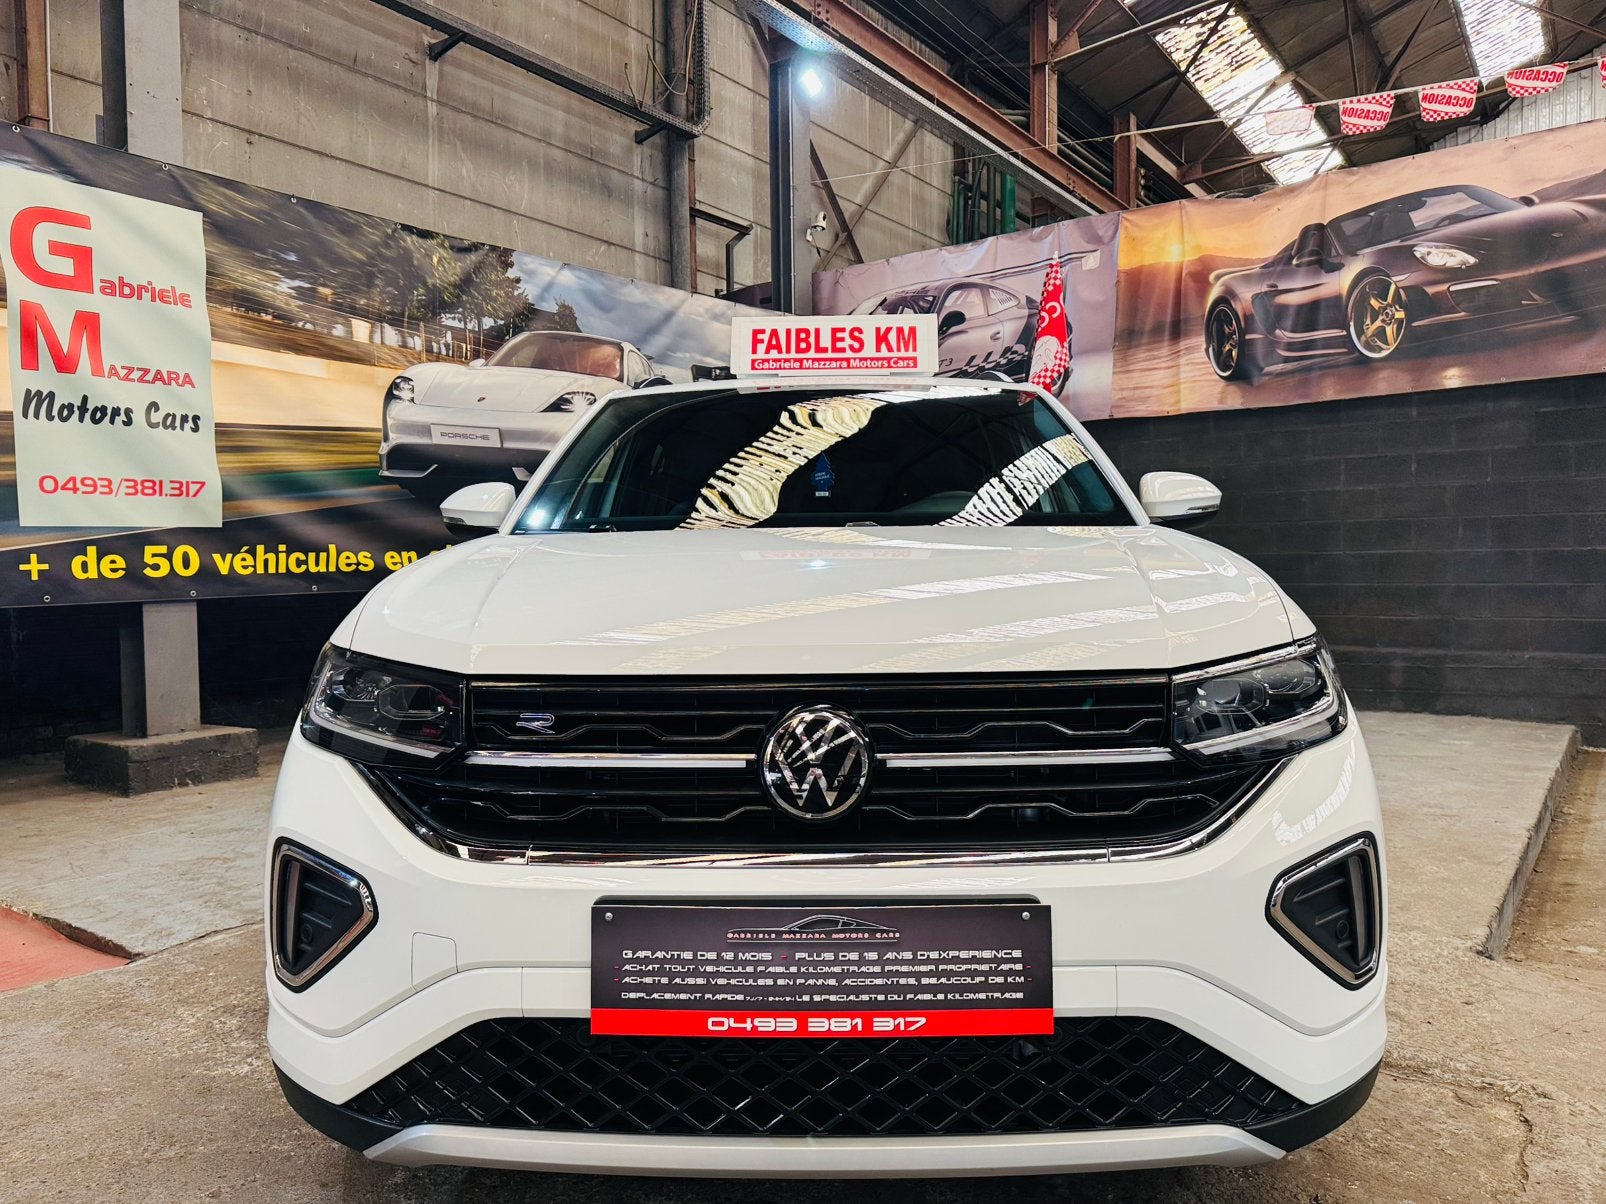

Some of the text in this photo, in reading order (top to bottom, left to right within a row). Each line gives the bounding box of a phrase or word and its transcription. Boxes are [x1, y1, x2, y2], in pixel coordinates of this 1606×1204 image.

[750, 325, 918, 355] FAIBLES KM
[754, 357, 914, 369] Gabriele Mazzara Motors Cars
[21, 387, 201, 433] Motors Cars
[440, 431, 490, 441] PORSCHE
[38, 474, 206, 498] 0493/381.317
[71, 546, 126, 580] de
[142, 545, 200, 578] 50
[212, 544, 374, 575] véhicules
[384, 550, 418, 571] en
[622, 950, 694, 960] GARANTIE
[697, 951, 718, 960] DE
[720, 951, 735, 961] 12
[738, 952, 773, 961] MOIS
[794, 952, 835, 961] PLUS
[838, 951, 860, 961] DE
[862, 951, 879, 961] 15
[882, 951, 914, 960] ANS
[917, 949, 1023, 960] D'EXPERIENCE
[621, 964, 661, 972] ACHAT
[698, 965, 755, 973] VEHICULE
[800, 965, 882, 973] KILOMETRAGE
[884, 964, 936, 973] PREMIER
[938, 963, 1024, 972] PROPRIETAIRE
[621, 976, 669, 984] ACHETE
[671, 977, 707, 985] AUSSI
[709, 977, 774, 986] VEHICULES
[776, 978, 794, 986] EN
[920, 976, 986, 985] BEAUCOUP
[988, 976, 1005, 984] DE
[1007, 975, 1025, 983] KM
[621, 992, 703, 1000] DEPLACEMENT
[795, 994, 811, 1002] LE
[947, 992, 1024, 1000] KILOMETRAGE
[707, 1016, 927, 1032] 0493 381 317
